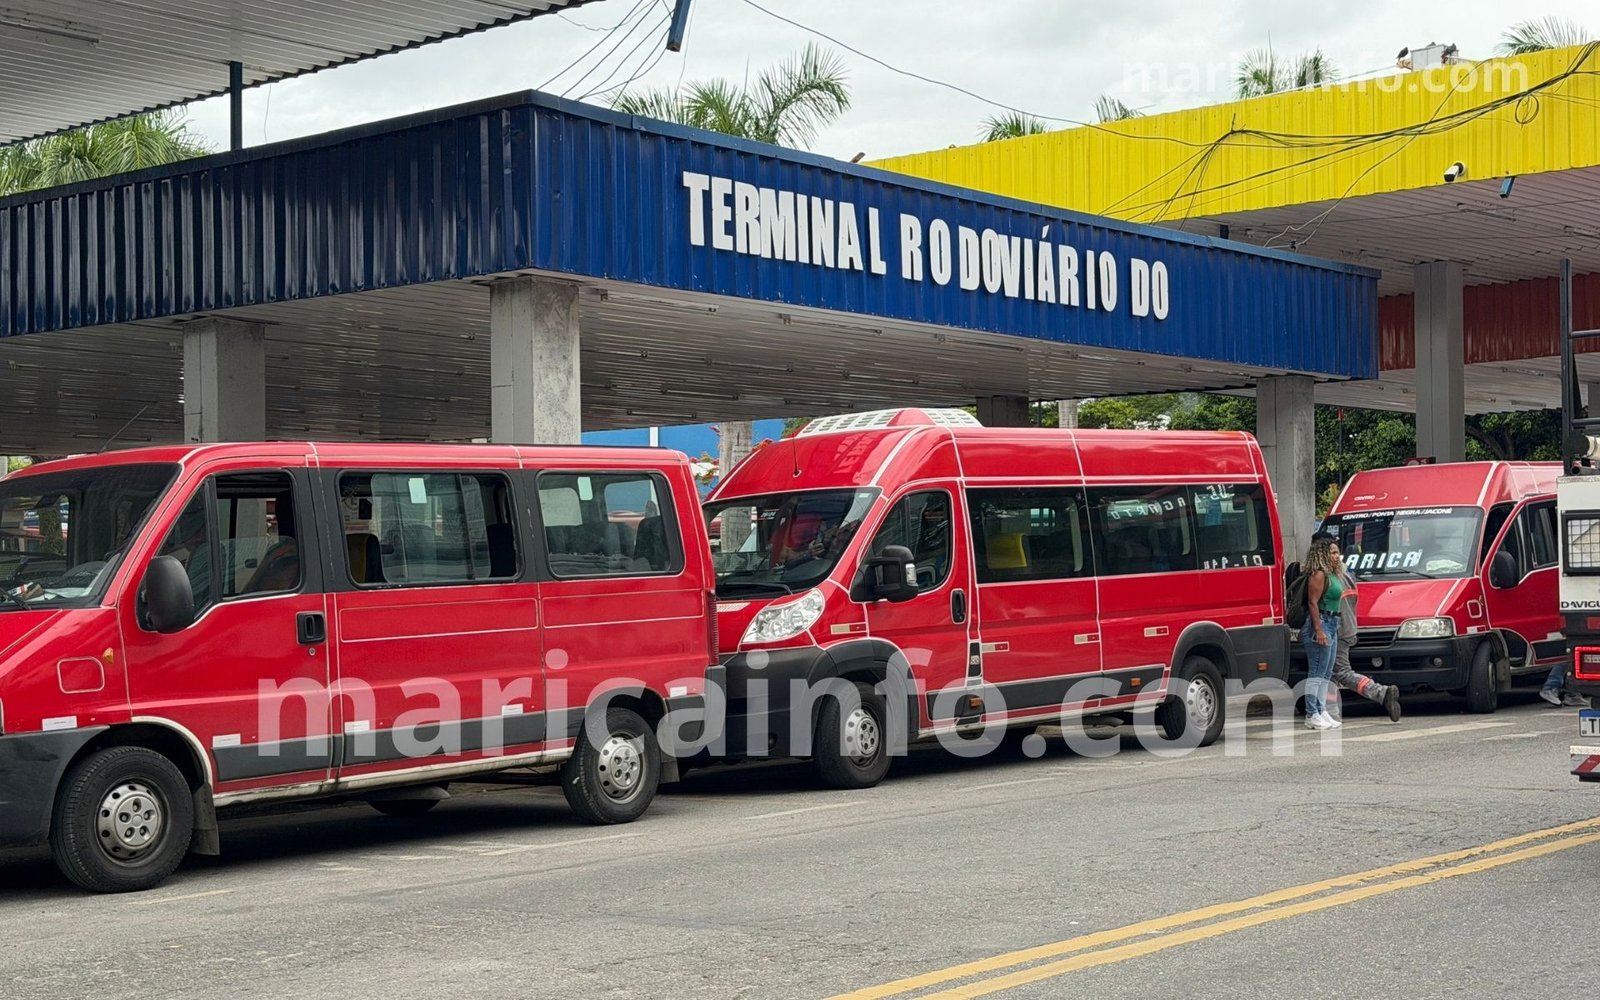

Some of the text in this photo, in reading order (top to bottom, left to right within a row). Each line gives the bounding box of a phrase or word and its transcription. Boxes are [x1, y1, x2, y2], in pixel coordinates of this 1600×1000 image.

[682, 171, 887, 275] TERMINAL
[1131, 258, 1169, 320] DO
[1340, 549, 1423, 569] ARICÁ
[1588, 718, 1600, 734] T
